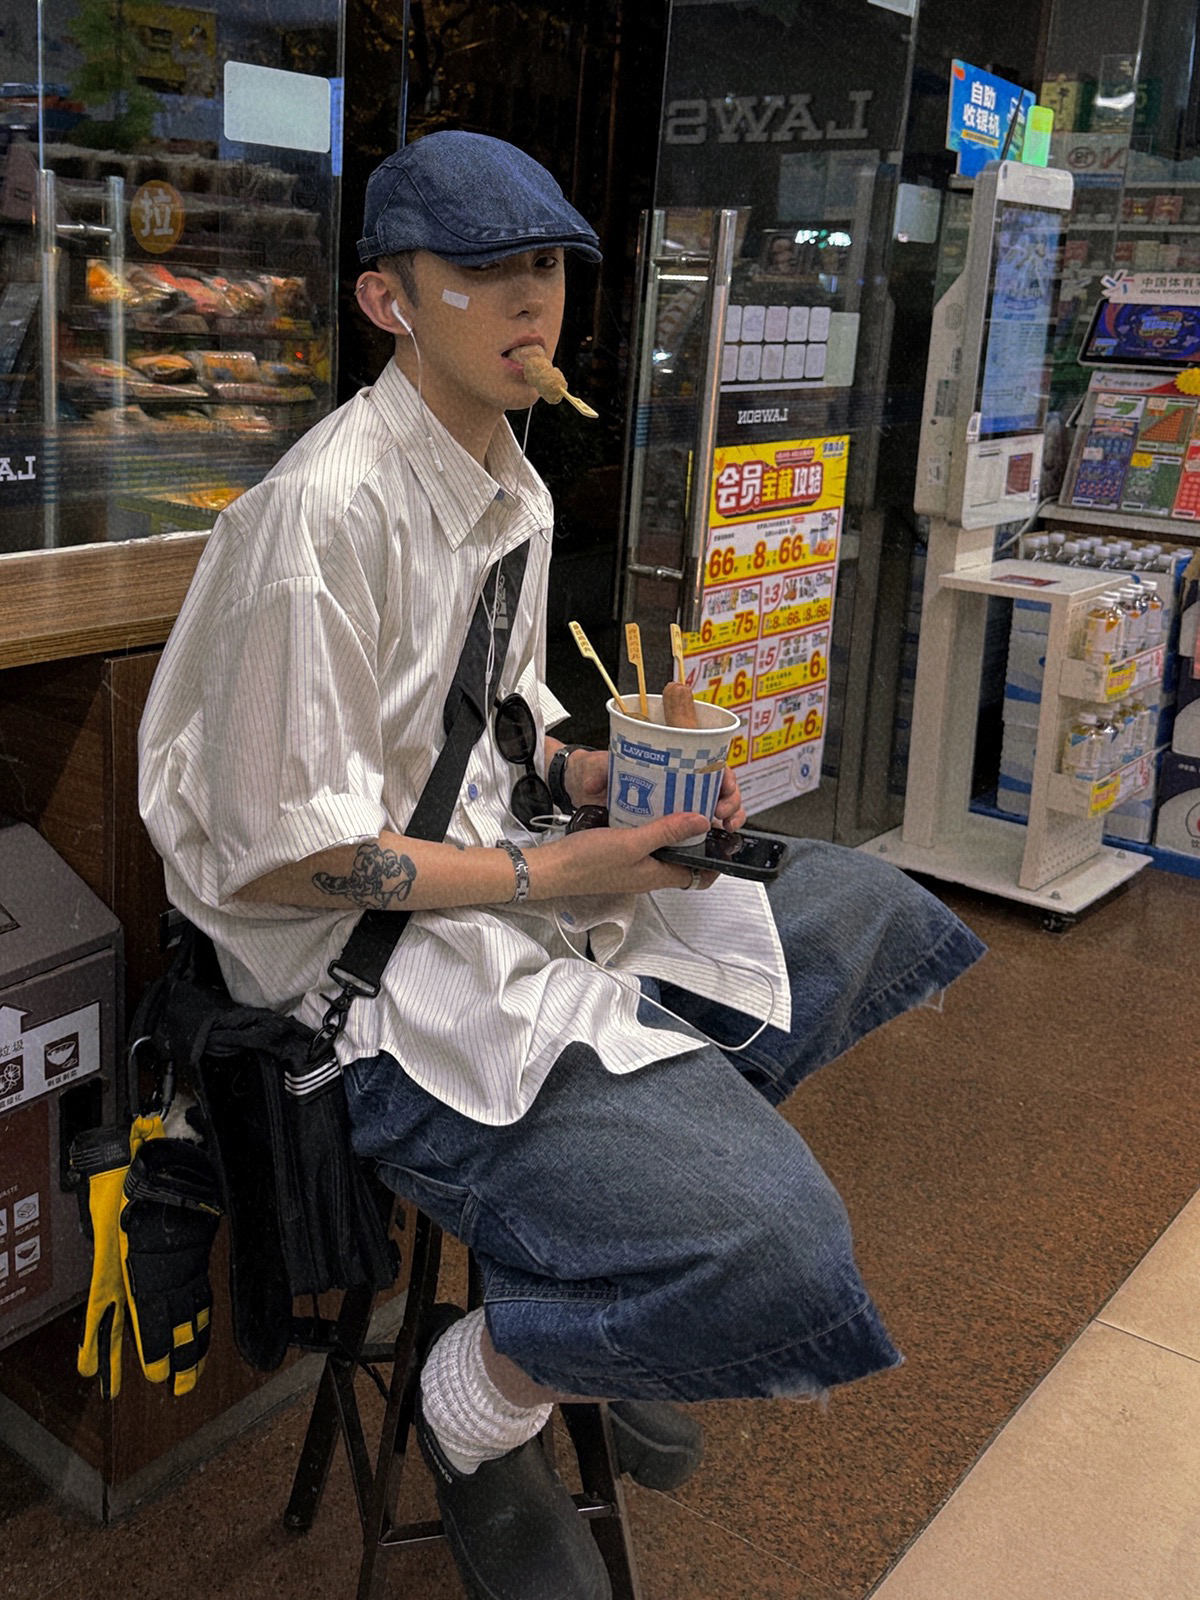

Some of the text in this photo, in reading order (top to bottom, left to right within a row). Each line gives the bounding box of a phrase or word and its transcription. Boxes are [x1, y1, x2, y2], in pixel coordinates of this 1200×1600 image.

[971, 81, 996, 110] 自助
[963, 103, 1000, 138] 收银机
[141, 188, 175, 237] 拉
[709, 547, 735, 578] 66
[779, 534, 803, 564] 66
[622, 744, 665, 762] LAWSON
[620, 774, 653, 789] LAWSON
[618, 800, 650, 814] STATION
